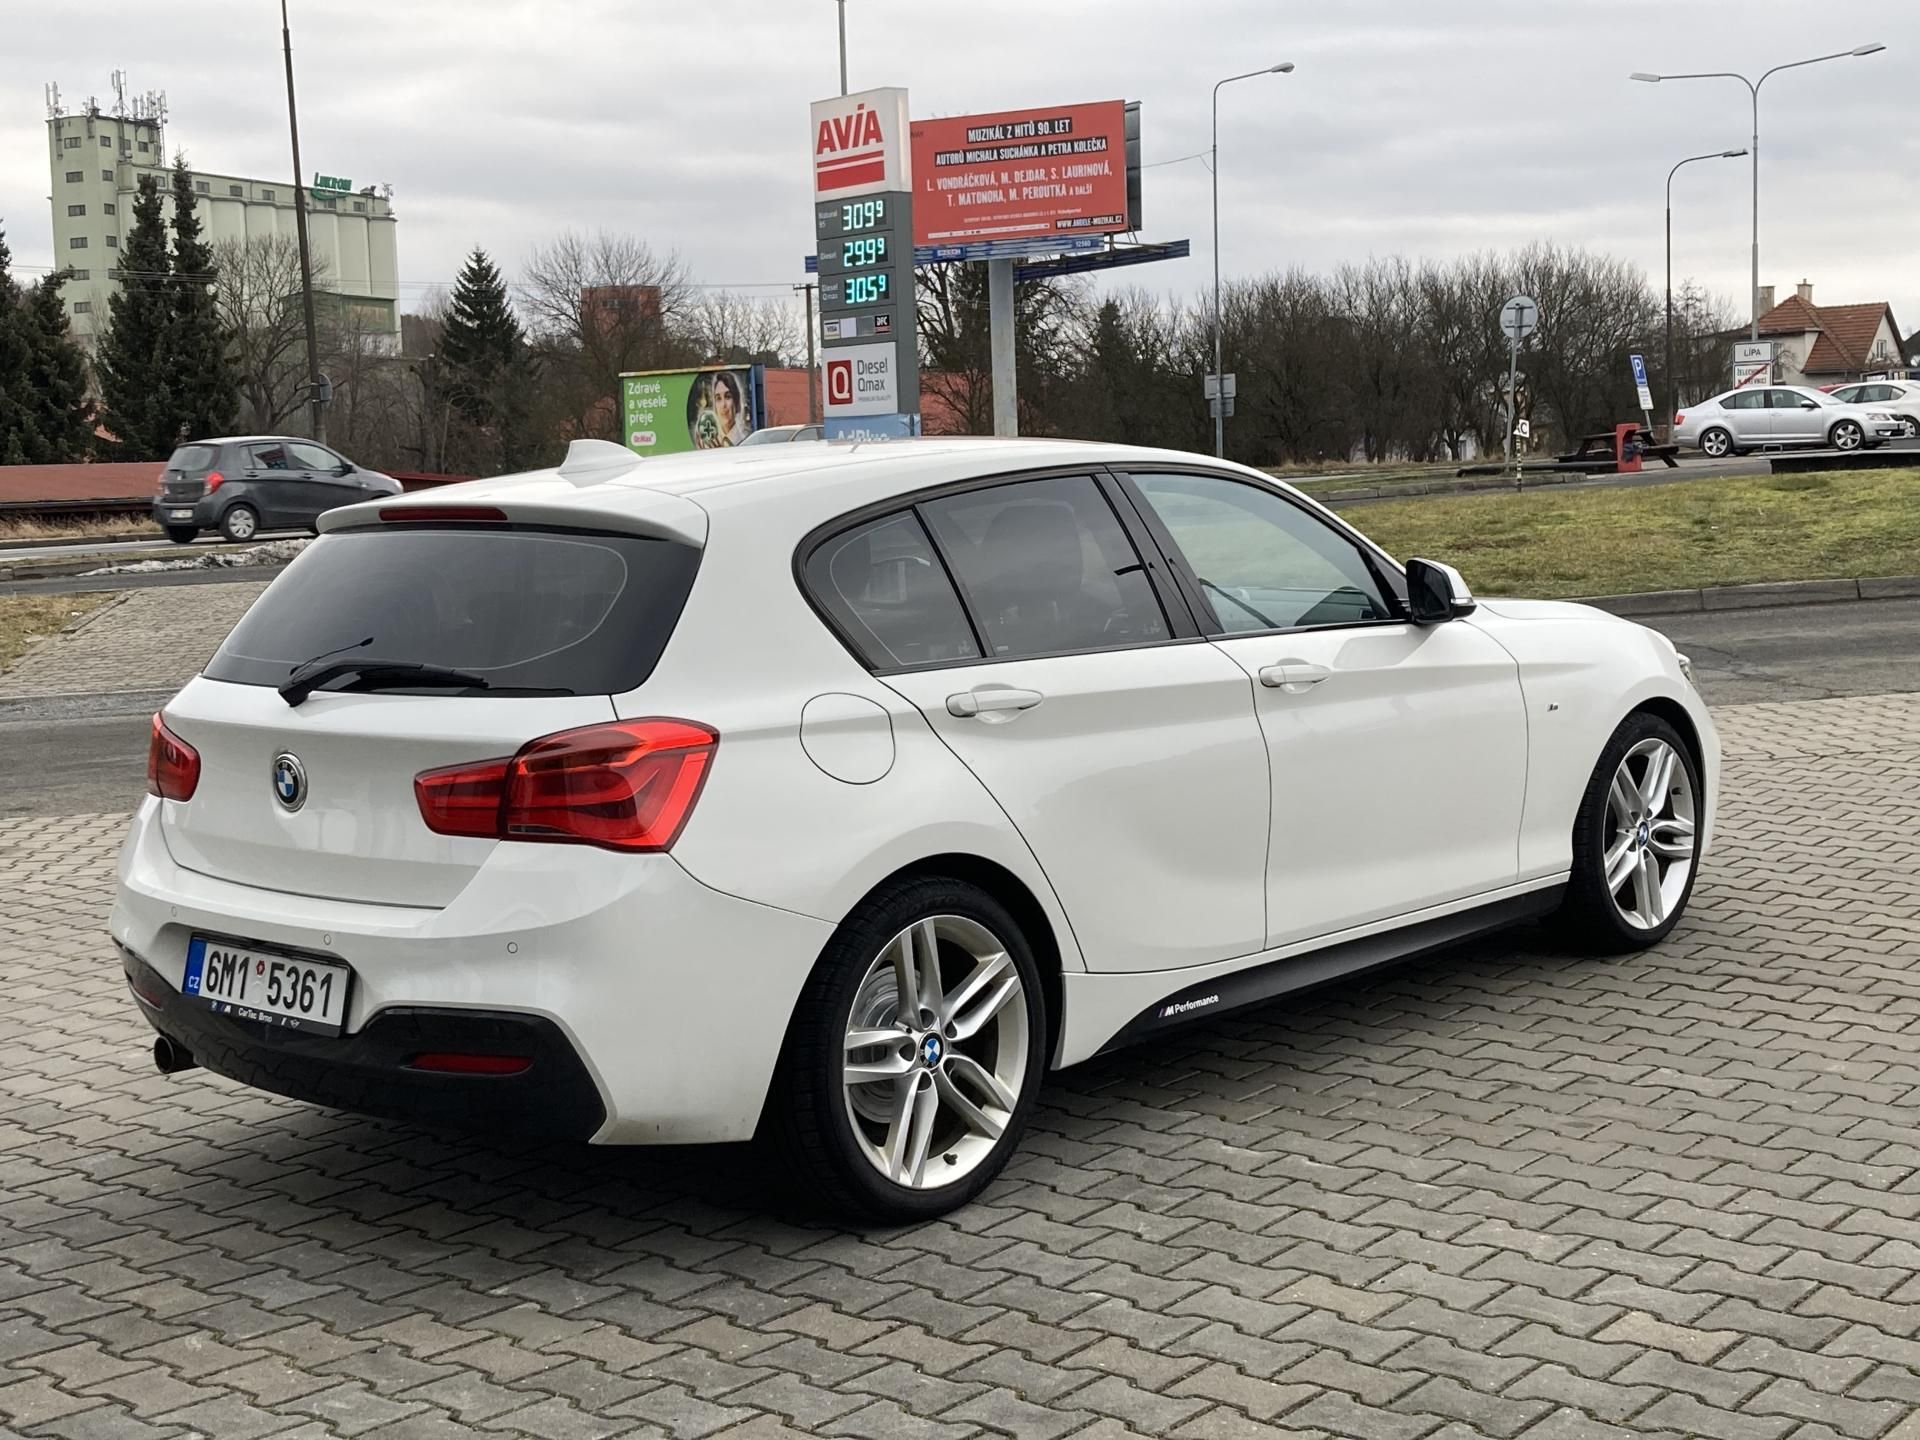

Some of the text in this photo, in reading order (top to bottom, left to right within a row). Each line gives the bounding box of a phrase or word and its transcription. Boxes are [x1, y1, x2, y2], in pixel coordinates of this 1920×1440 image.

[968, 119, 1071, 142] MUZIKÁL Z HITŮ 90. LET
[936, 137, 1107, 166] AUTORŮ MICHALA SUCHÁNKA A PETRA KOLEČKA
[1001, 172, 1012, 185] M.
[1013, 168, 1049, 184] DEJDAR,
[1050, 167, 1060, 180] S.
[1062, 160, 1113, 179] LAURINOVÁ,
[947, 194, 956, 207] T.
[958, 189, 1007, 206] MATONOHA,
[1008, 188, 1020, 201] M.
[1022, 184, 1067, 200] PEROUTKA
[857, 358, 888, 375] Diesel
[628, 380, 661, 395] Zdravé
[858, 377, 885, 392] Qmax
[629, 394, 667, 409] a veselé
[629, 410, 654, 426] přeje
[188, 975, 200, 989] CZ
[206, 950, 333, 1018] 6M1 5361
[1174, 994, 1219, 1014] Performance
